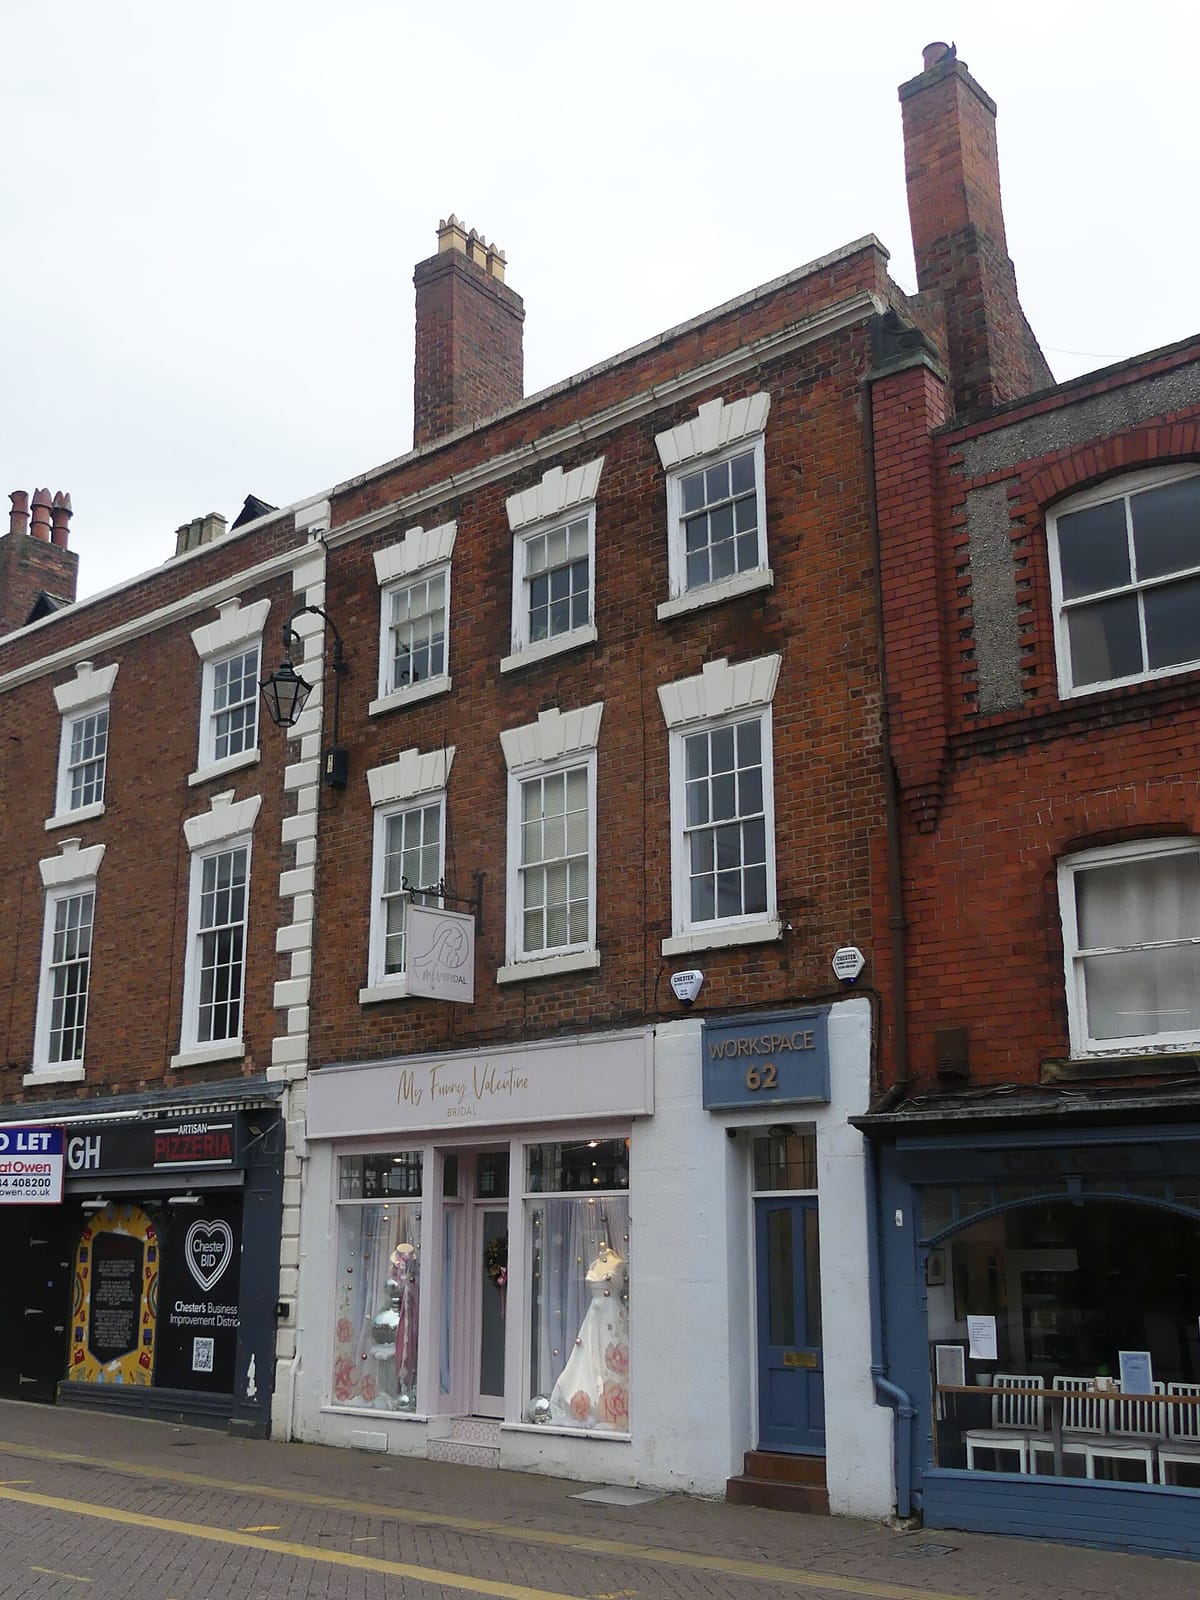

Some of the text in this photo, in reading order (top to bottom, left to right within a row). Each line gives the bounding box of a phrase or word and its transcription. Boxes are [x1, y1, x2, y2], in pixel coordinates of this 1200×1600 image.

[708, 1030, 816, 1059] WORKSPACE
[745, 1062, 777, 1089] 62
[397, 1063, 529, 1106] My Funny Valentine
[447, 1106, 477, 1118] BRIDAL
[178, 1123, 208, 1135] ARTISAN
[16, 1133, 52, 1151] LET
[154, 1134, 231, 1161] PIZZERIA
[12, 1178, 51, 1187] 408200
[193, 1239, 224, 1252] Chester
[200, 1254, 216, 1267] BID
[175, 1301, 238, 1314] Chester's Business
[170, 1313, 215, 1327] Improvement
